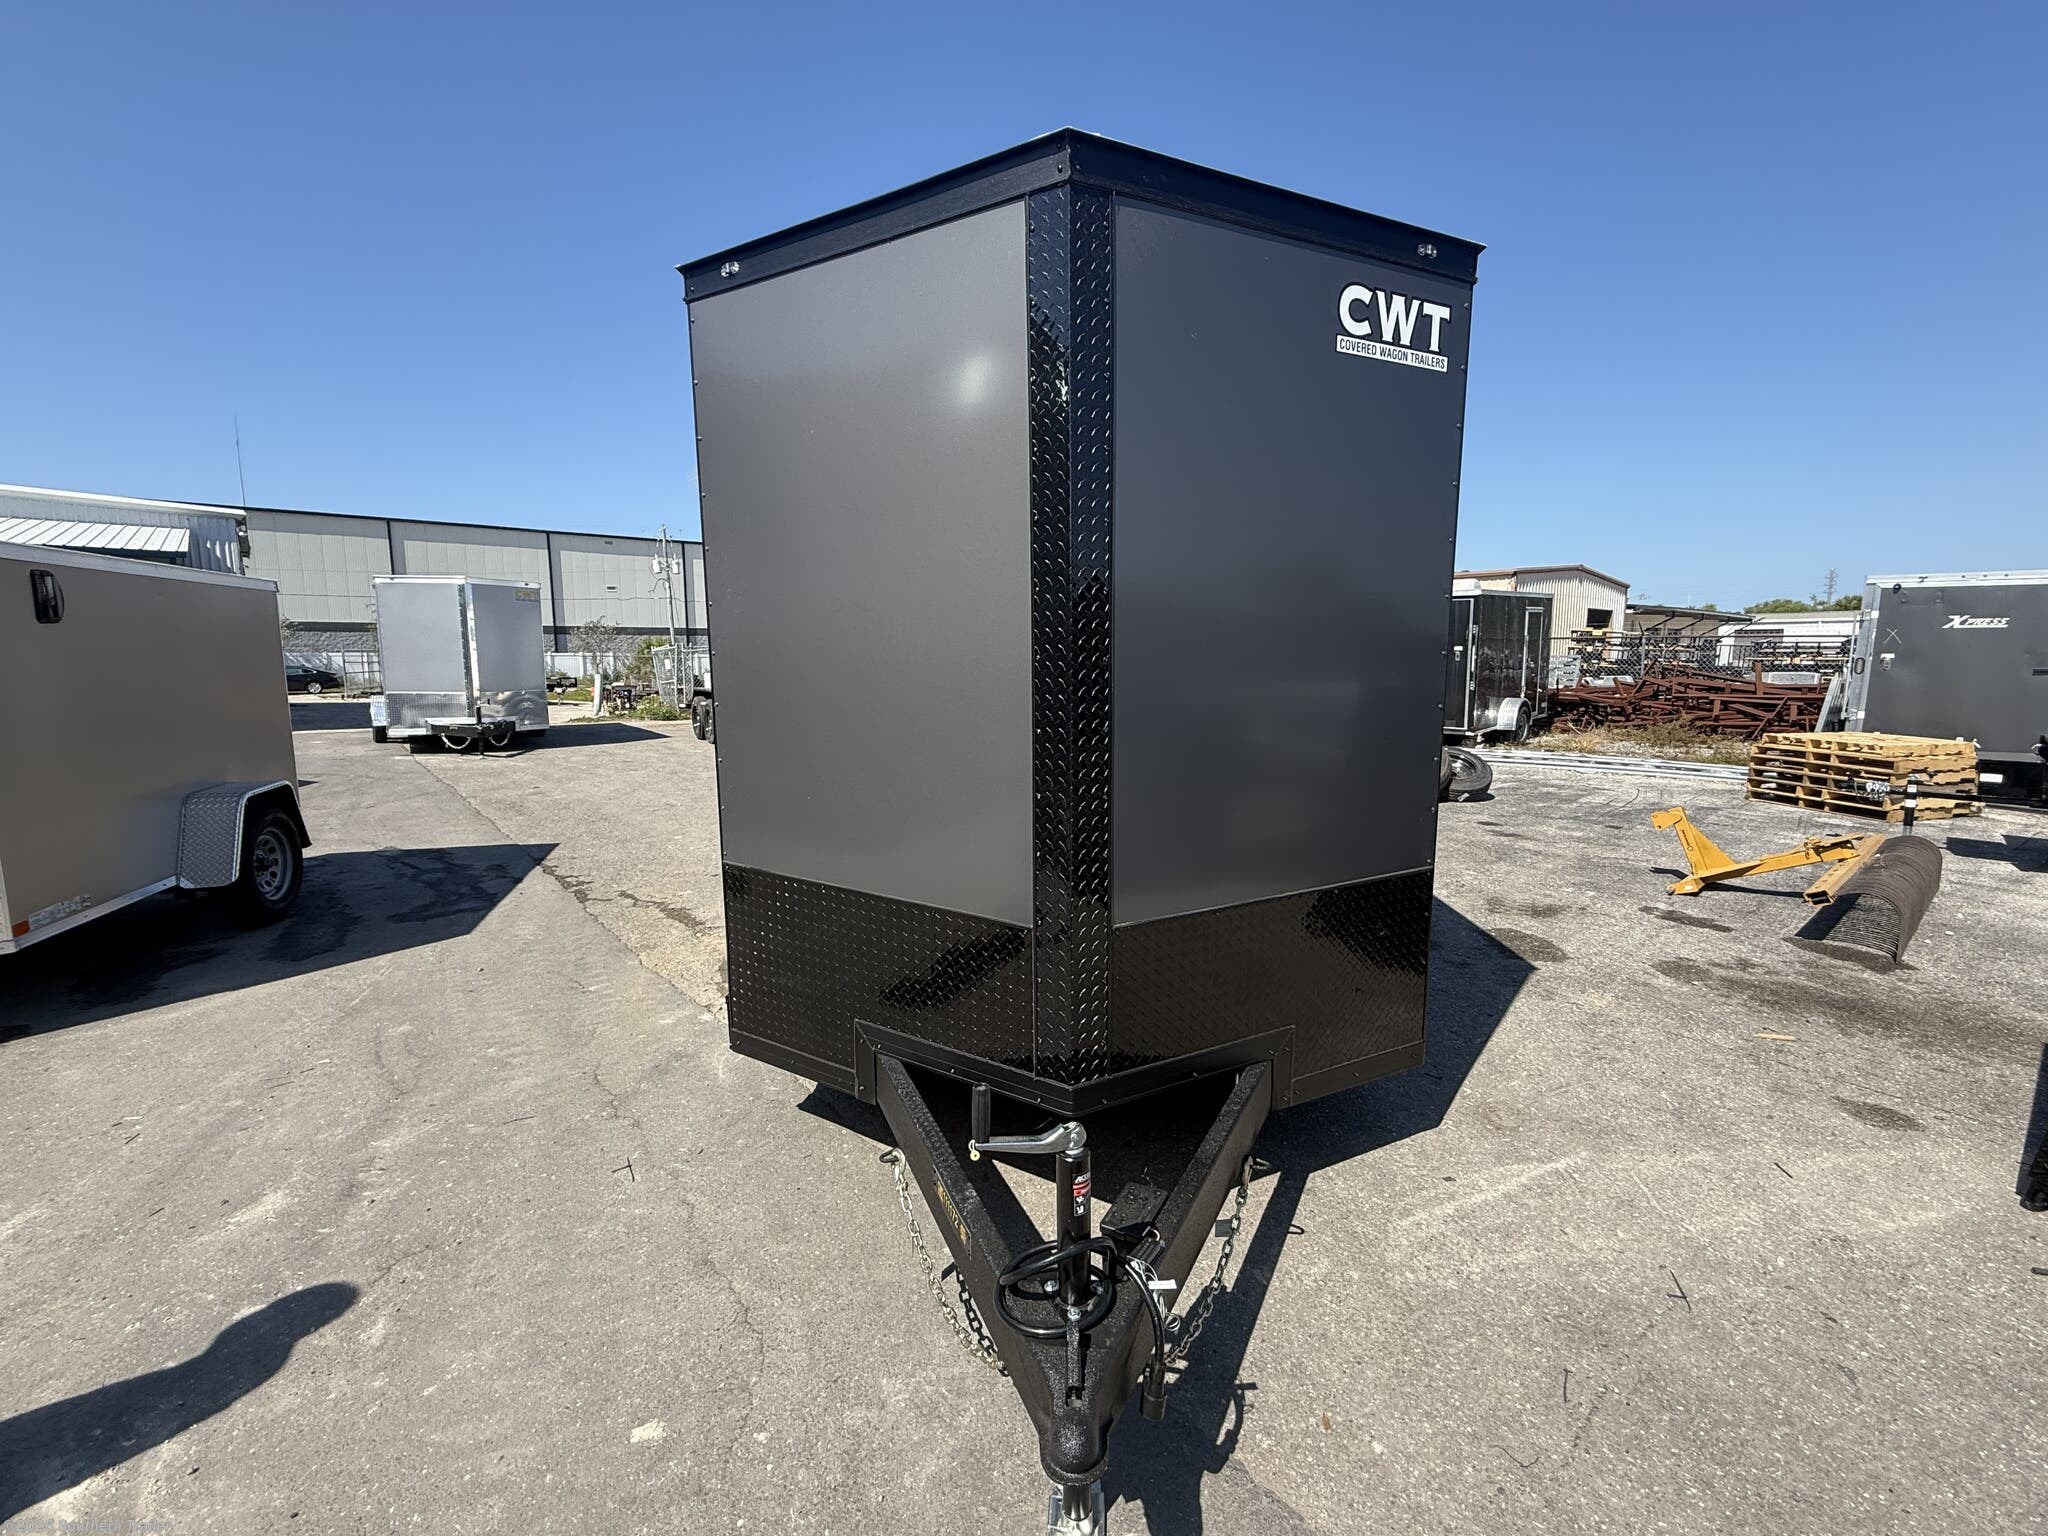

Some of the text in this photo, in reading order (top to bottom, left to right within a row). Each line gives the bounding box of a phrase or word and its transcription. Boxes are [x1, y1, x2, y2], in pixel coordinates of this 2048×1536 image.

[1339, 284, 1450, 352] CWT
[1339, 338, 1446, 370] COVERED WAGON TRAILERS
